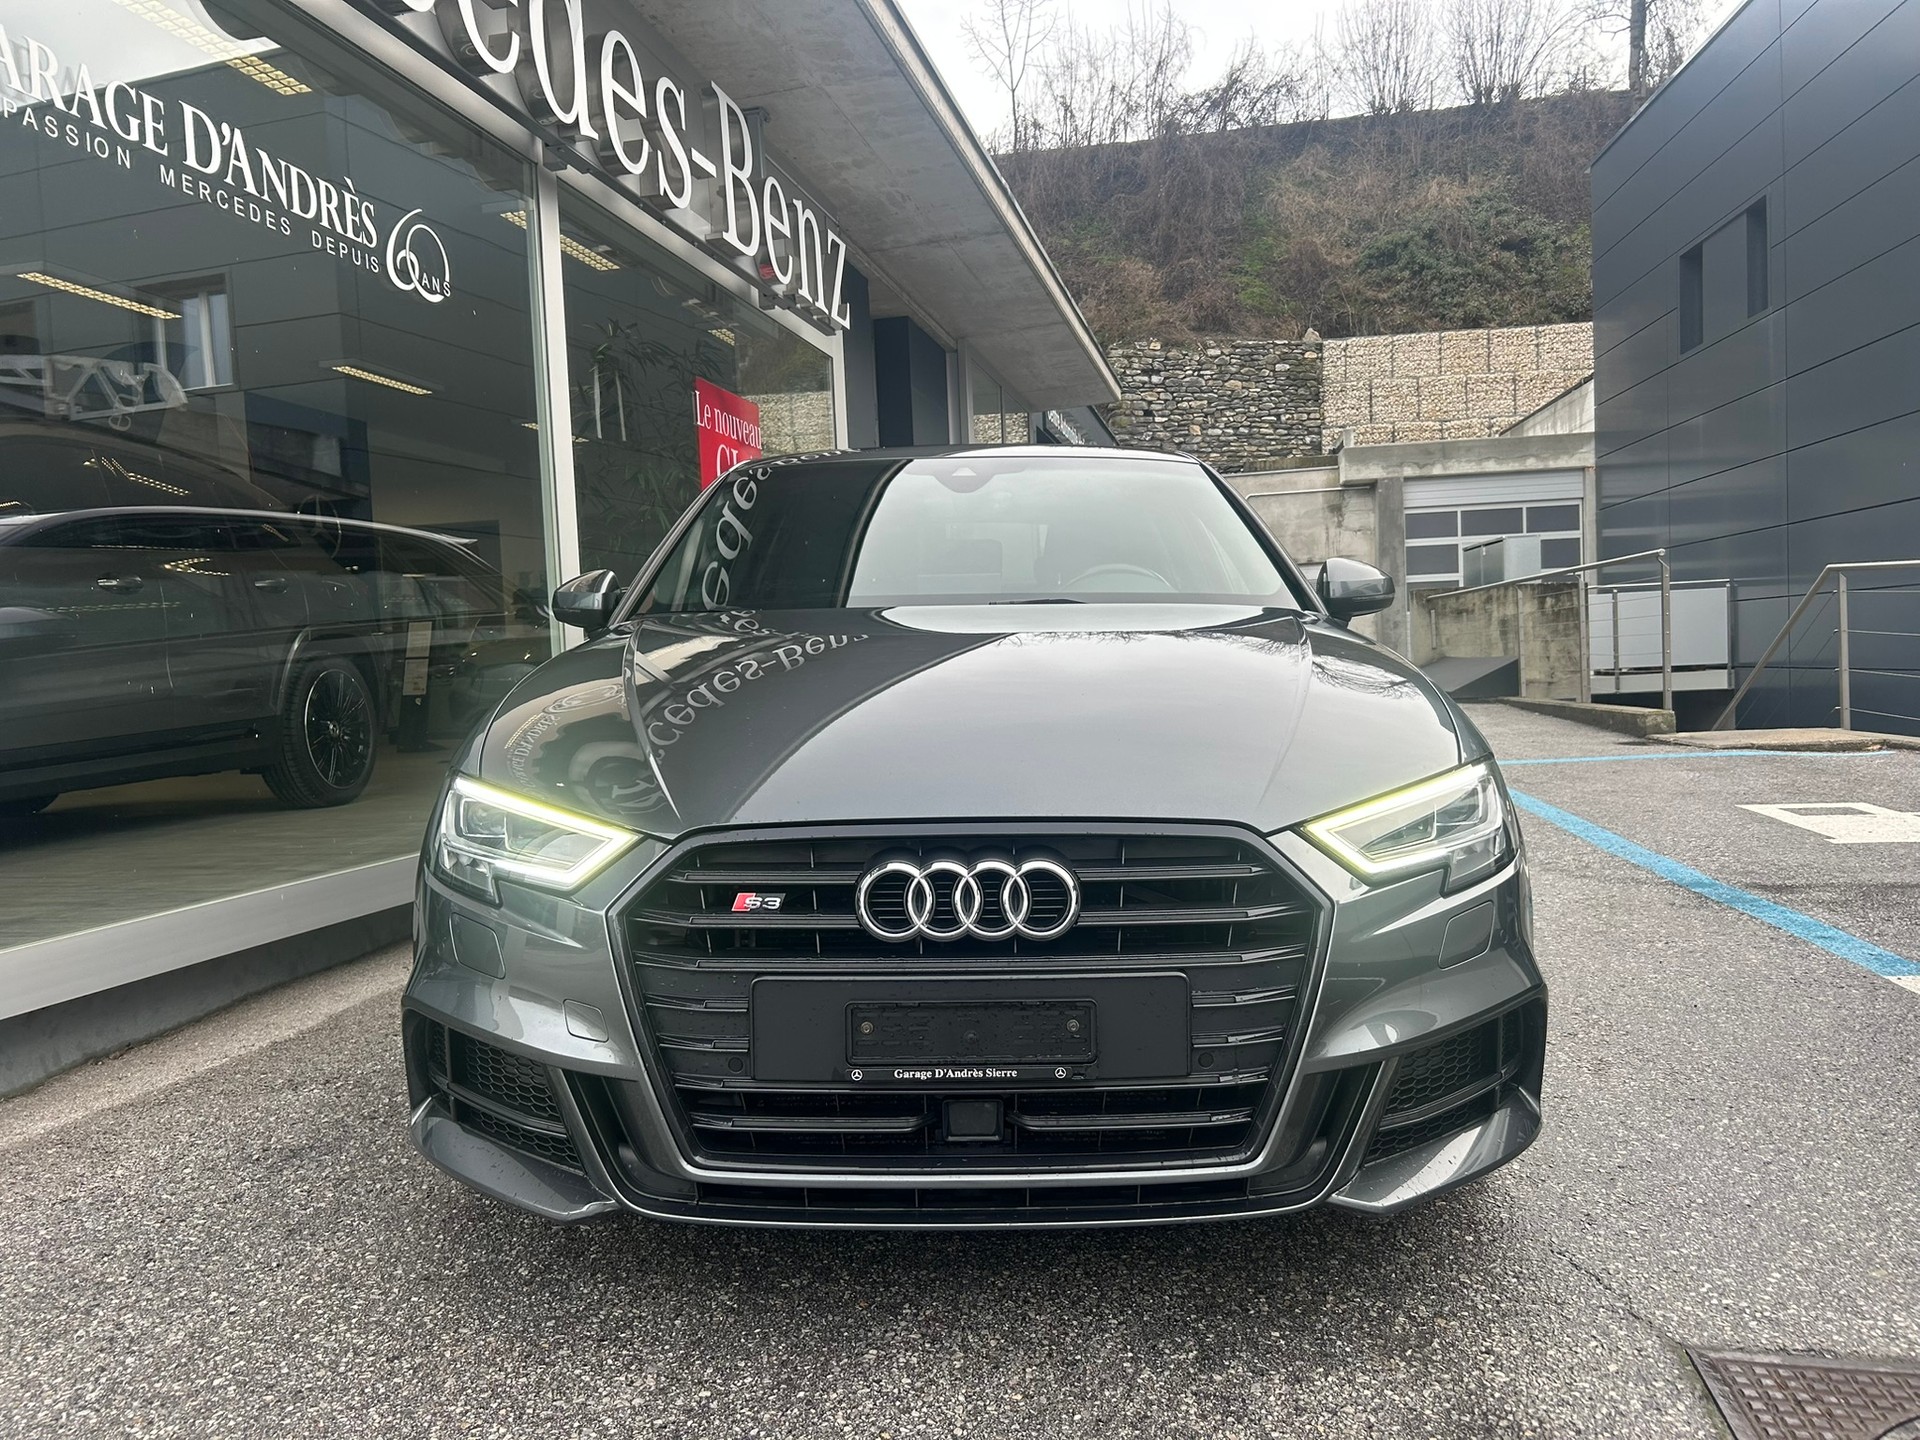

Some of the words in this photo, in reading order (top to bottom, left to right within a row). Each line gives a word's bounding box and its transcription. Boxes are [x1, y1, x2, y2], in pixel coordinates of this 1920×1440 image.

[3, 97, 131, 169] PASSION
[159, 164, 291, 236] MERCEDES
[311, 230, 380, 273] DEPUIS
[421, 272, 451, 297] ANS
[179, 100, 378, 248] D'ANDRÈS
[396, 0, 850, 329] des-Benz
[695, 390, 711, 430] Le
[714, 408, 763, 450] nouveau
[743, 897, 781, 910] S3
[894, 1069, 933, 1081] Garage
[935, 1068, 984, 1079] D'Andrès
[985, 1068, 1018, 1078] Sierre
